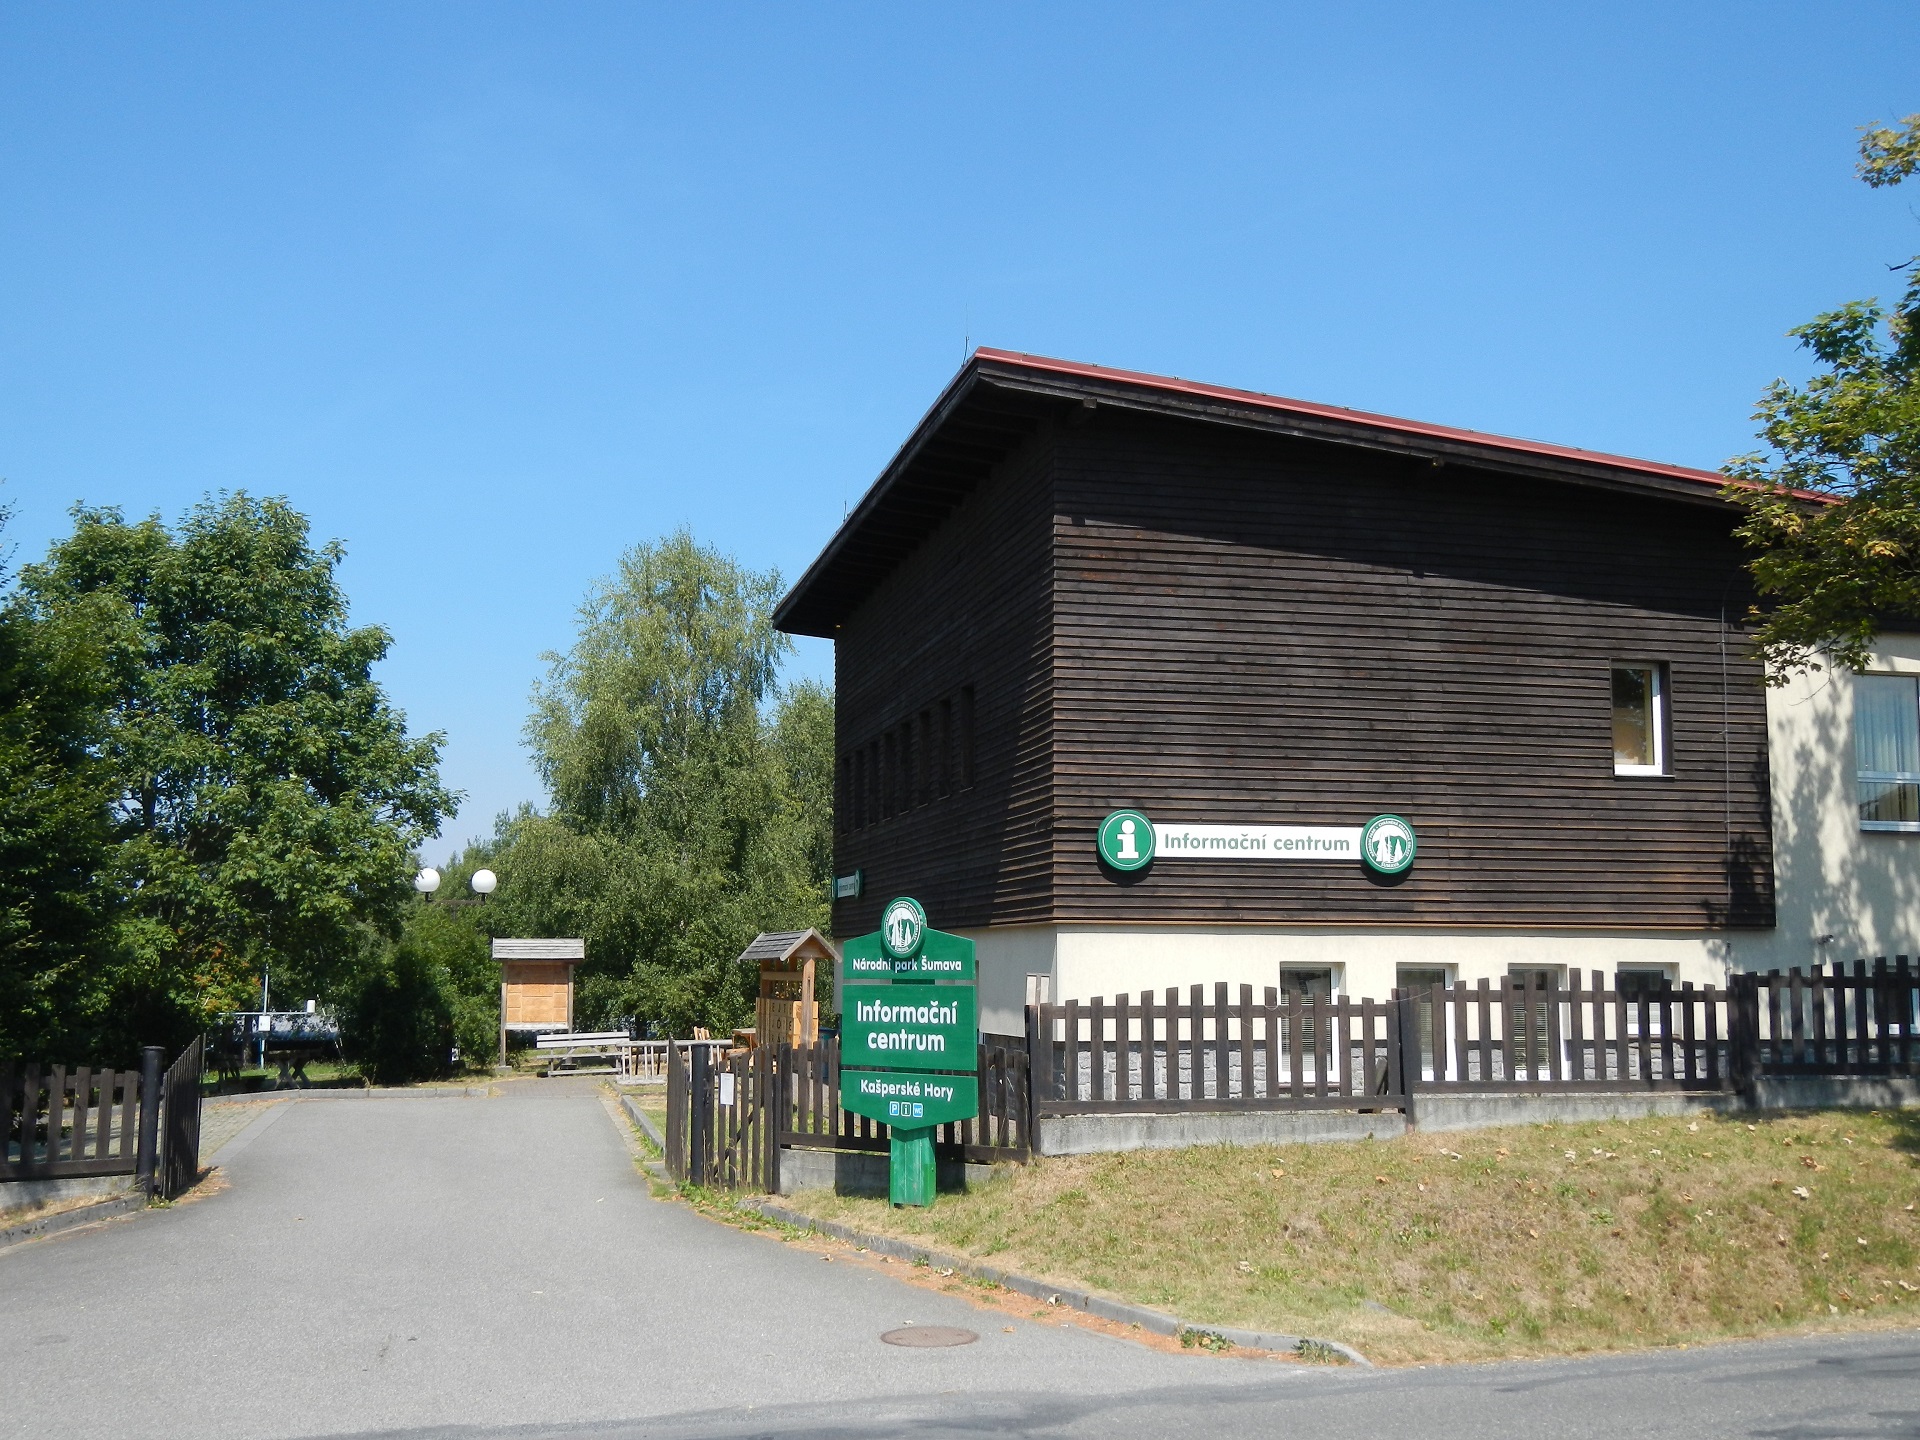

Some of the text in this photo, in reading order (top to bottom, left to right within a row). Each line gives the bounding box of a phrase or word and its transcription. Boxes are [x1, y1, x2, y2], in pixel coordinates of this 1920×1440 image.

[1164, 833, 1267, 851] Informační
[1273, 836, 1350, 852] centrum
[852, 955, 962, 973] Národní park Šumava
[856, 1000, 958, 1024] Informační
[867, 1029, 945, 1051] centrum
[860, 1079, 954, 1102] Kašperské Hory
